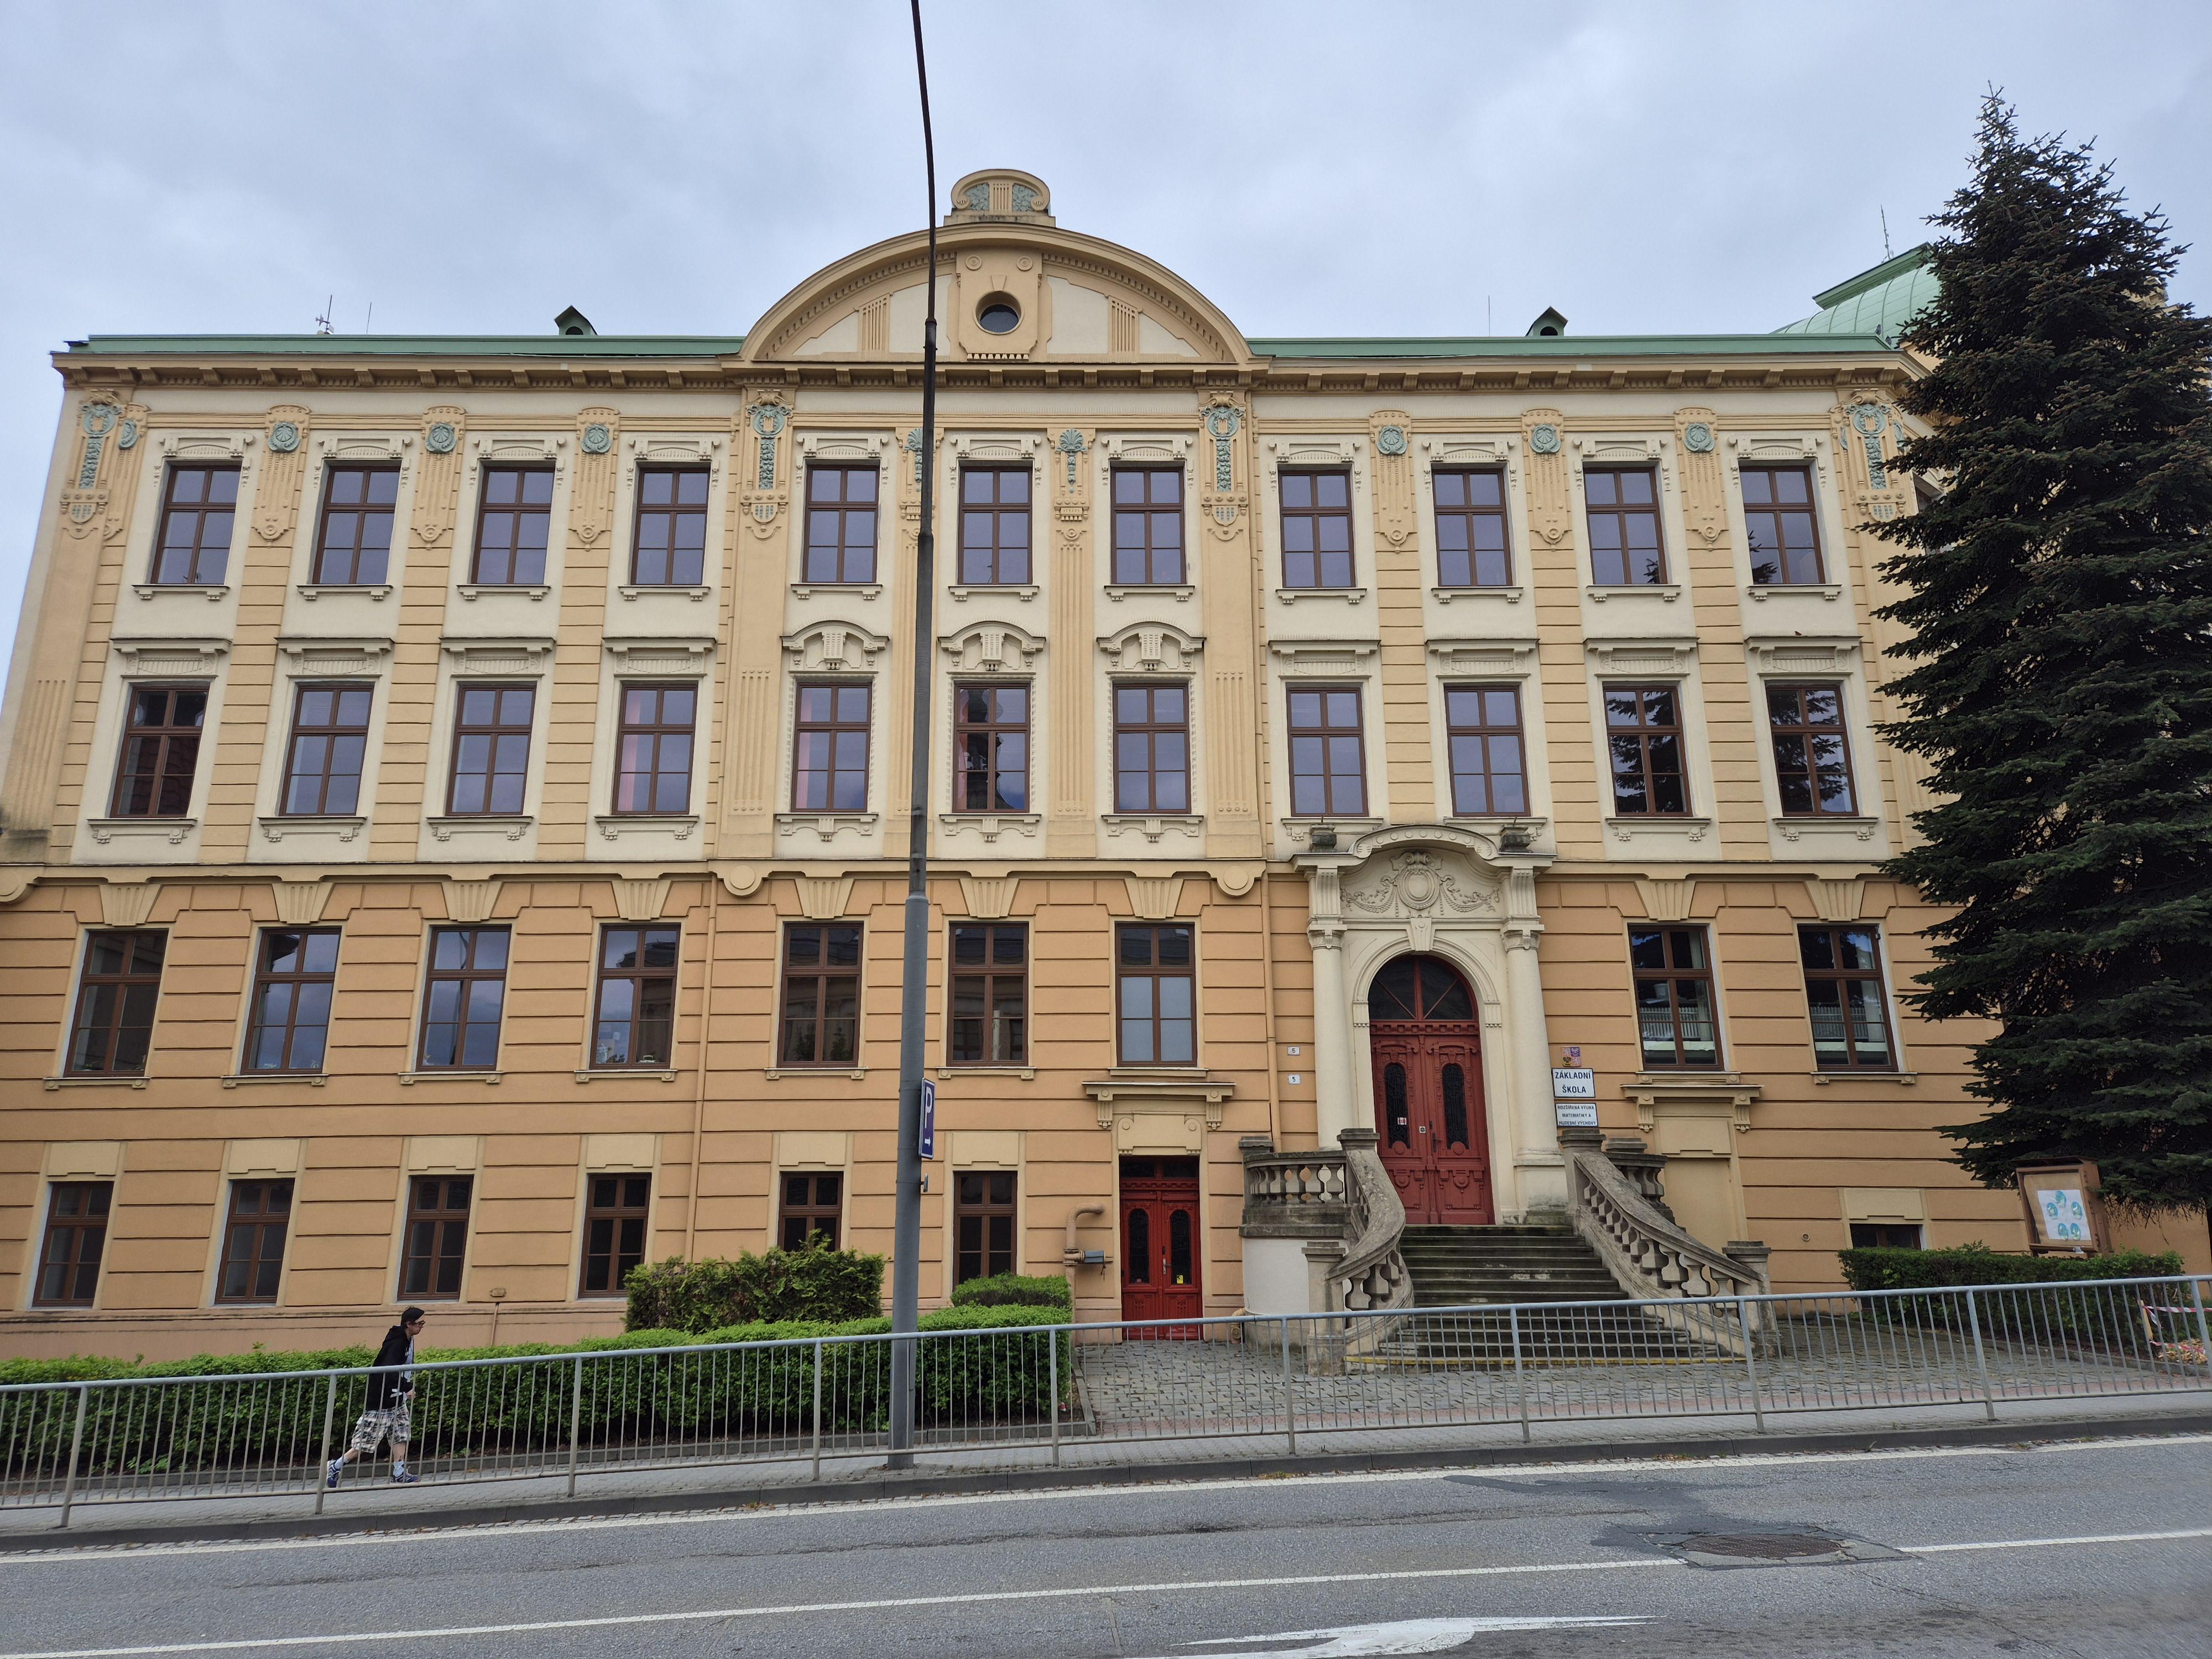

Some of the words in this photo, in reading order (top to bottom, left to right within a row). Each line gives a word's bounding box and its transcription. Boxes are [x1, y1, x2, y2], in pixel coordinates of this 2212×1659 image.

[1555, 1071, 1591, 1079] ZÁKLADNÍ
[1562, 1084, 1587, 1093] ŠKOLA
[925, 1087, 932, 1129] P
